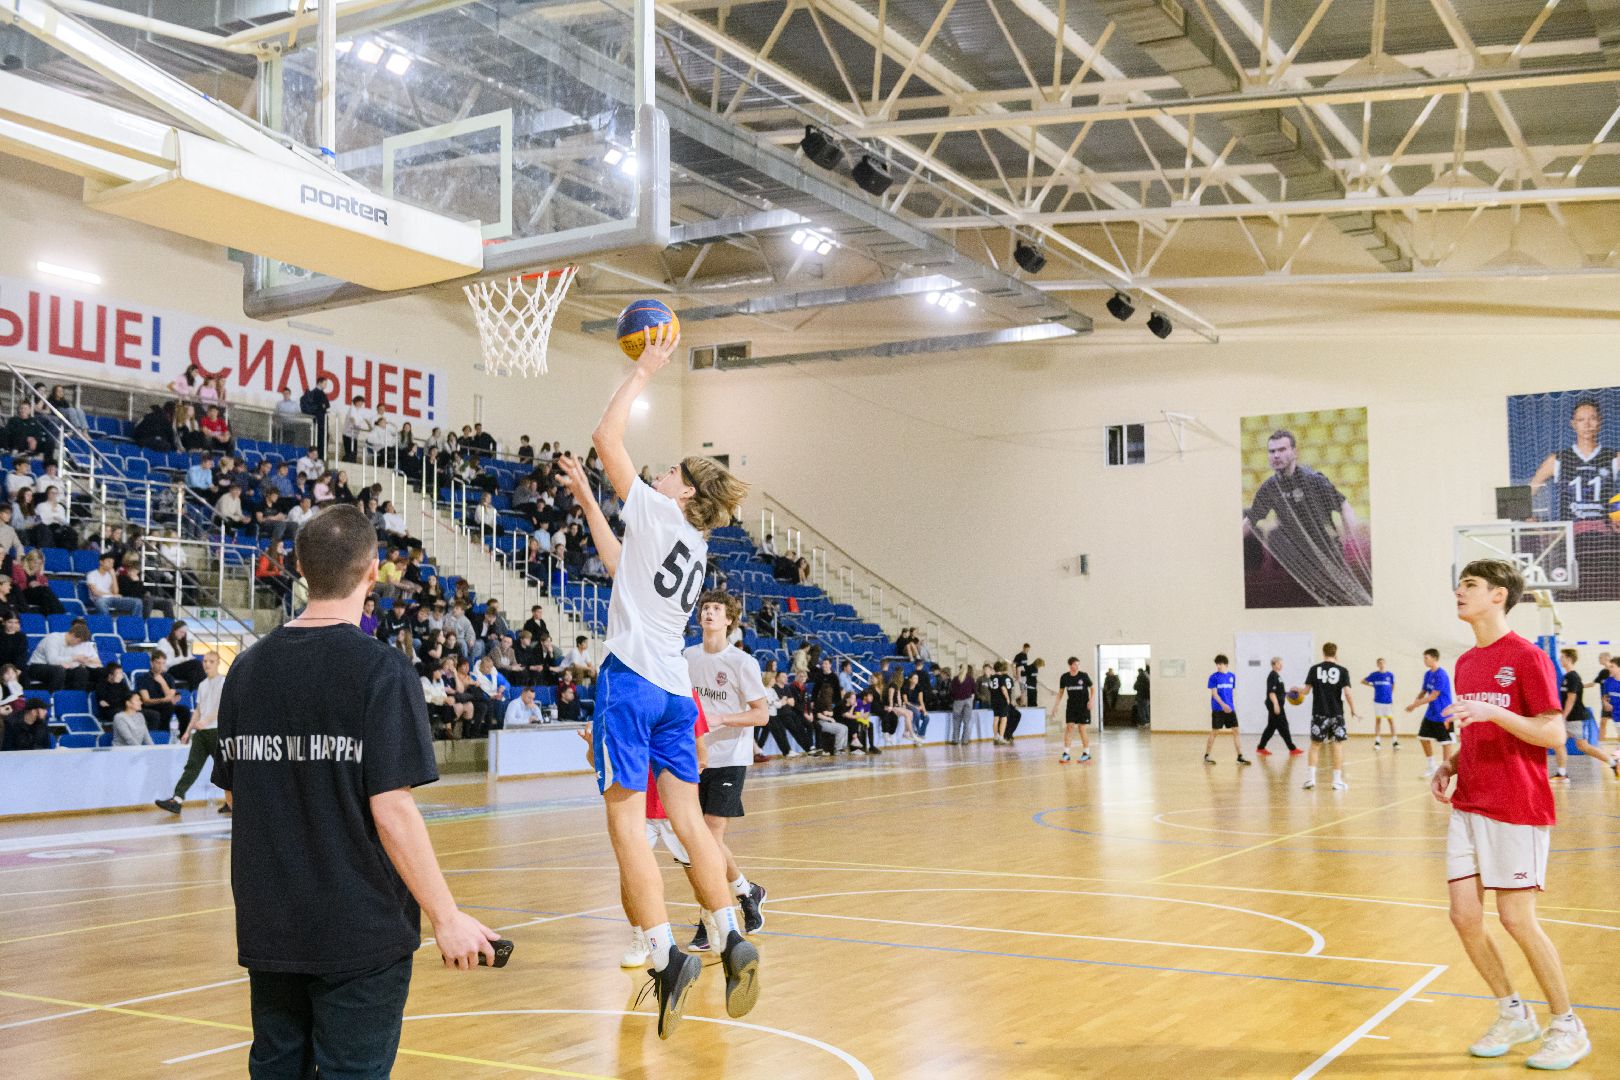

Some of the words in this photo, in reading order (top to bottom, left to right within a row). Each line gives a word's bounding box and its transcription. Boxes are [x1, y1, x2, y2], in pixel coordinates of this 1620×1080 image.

[189, 326, 435, 421] СИЛЬНЕЕ!
[1569, 476, 1601, 502] 11
[654, 540, 704, 613] 50
[1316, 666, 1341, 684] 49
[310, 734, 363, 763] HAPPEN
